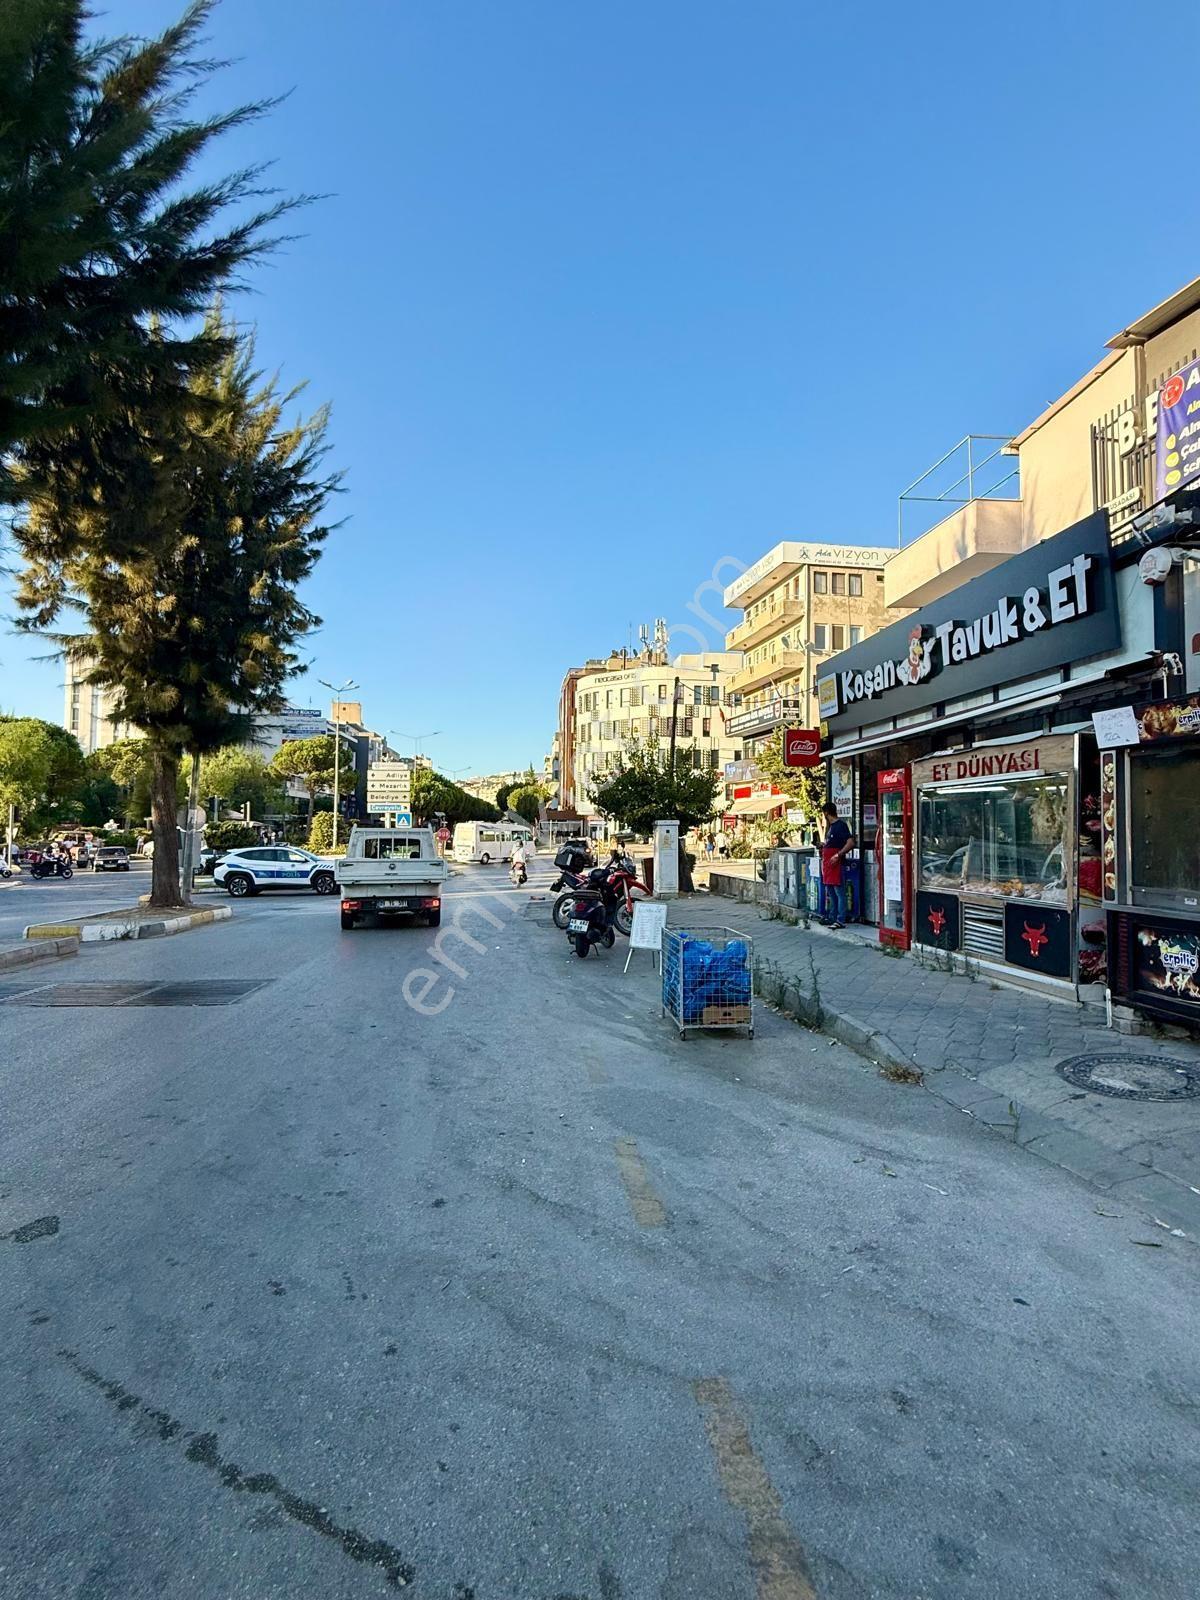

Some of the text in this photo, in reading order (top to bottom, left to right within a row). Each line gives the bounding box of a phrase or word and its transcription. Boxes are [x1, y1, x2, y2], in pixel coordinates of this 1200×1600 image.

[841, 659, 896, 705] Koşan
[936, 597, 1019, 667] Tavuk
[1022, 586, 1048, 632] &
[932, 748, 1040, 782] ET DÜNYASI
[281, 869, 301, 878] POLİS
